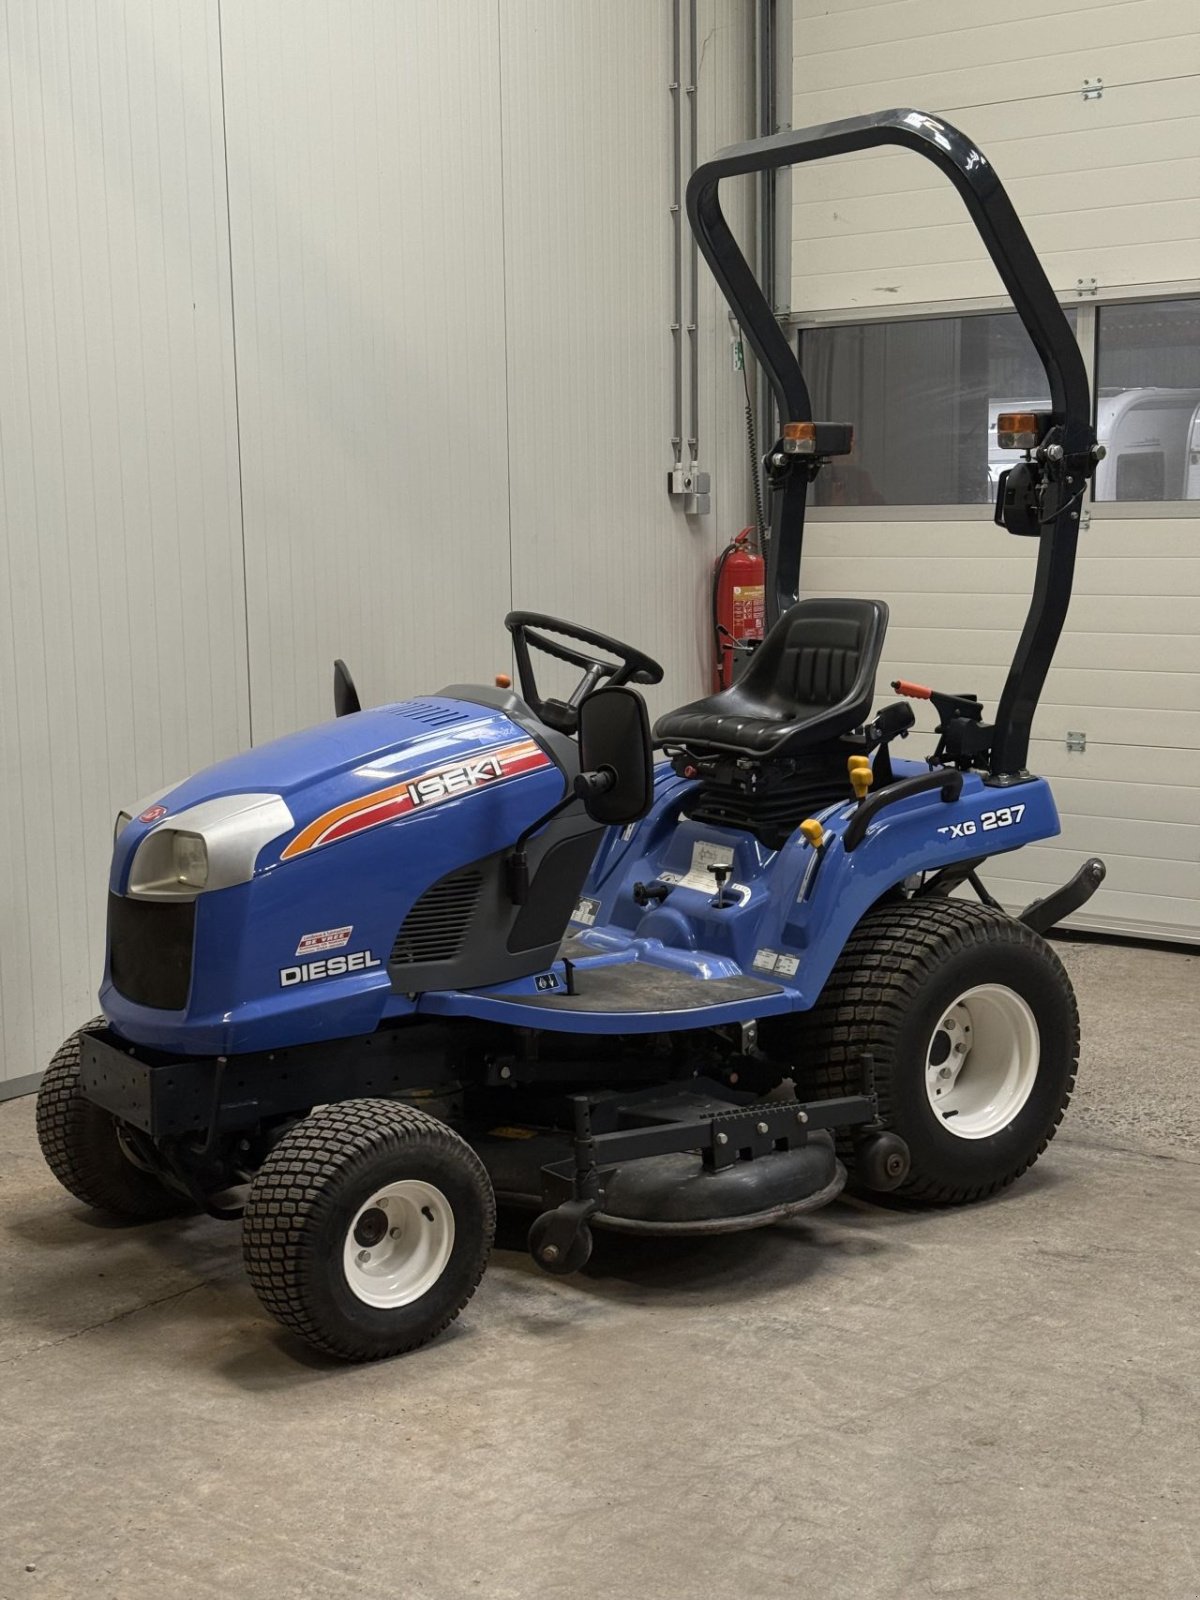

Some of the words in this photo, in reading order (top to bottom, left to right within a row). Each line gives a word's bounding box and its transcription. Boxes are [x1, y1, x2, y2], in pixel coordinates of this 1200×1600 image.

[406, 756, 503, 806] ISEKI
[980, 803, 1026, 831] 237
[279, 950, 381, 987] DIESEL
